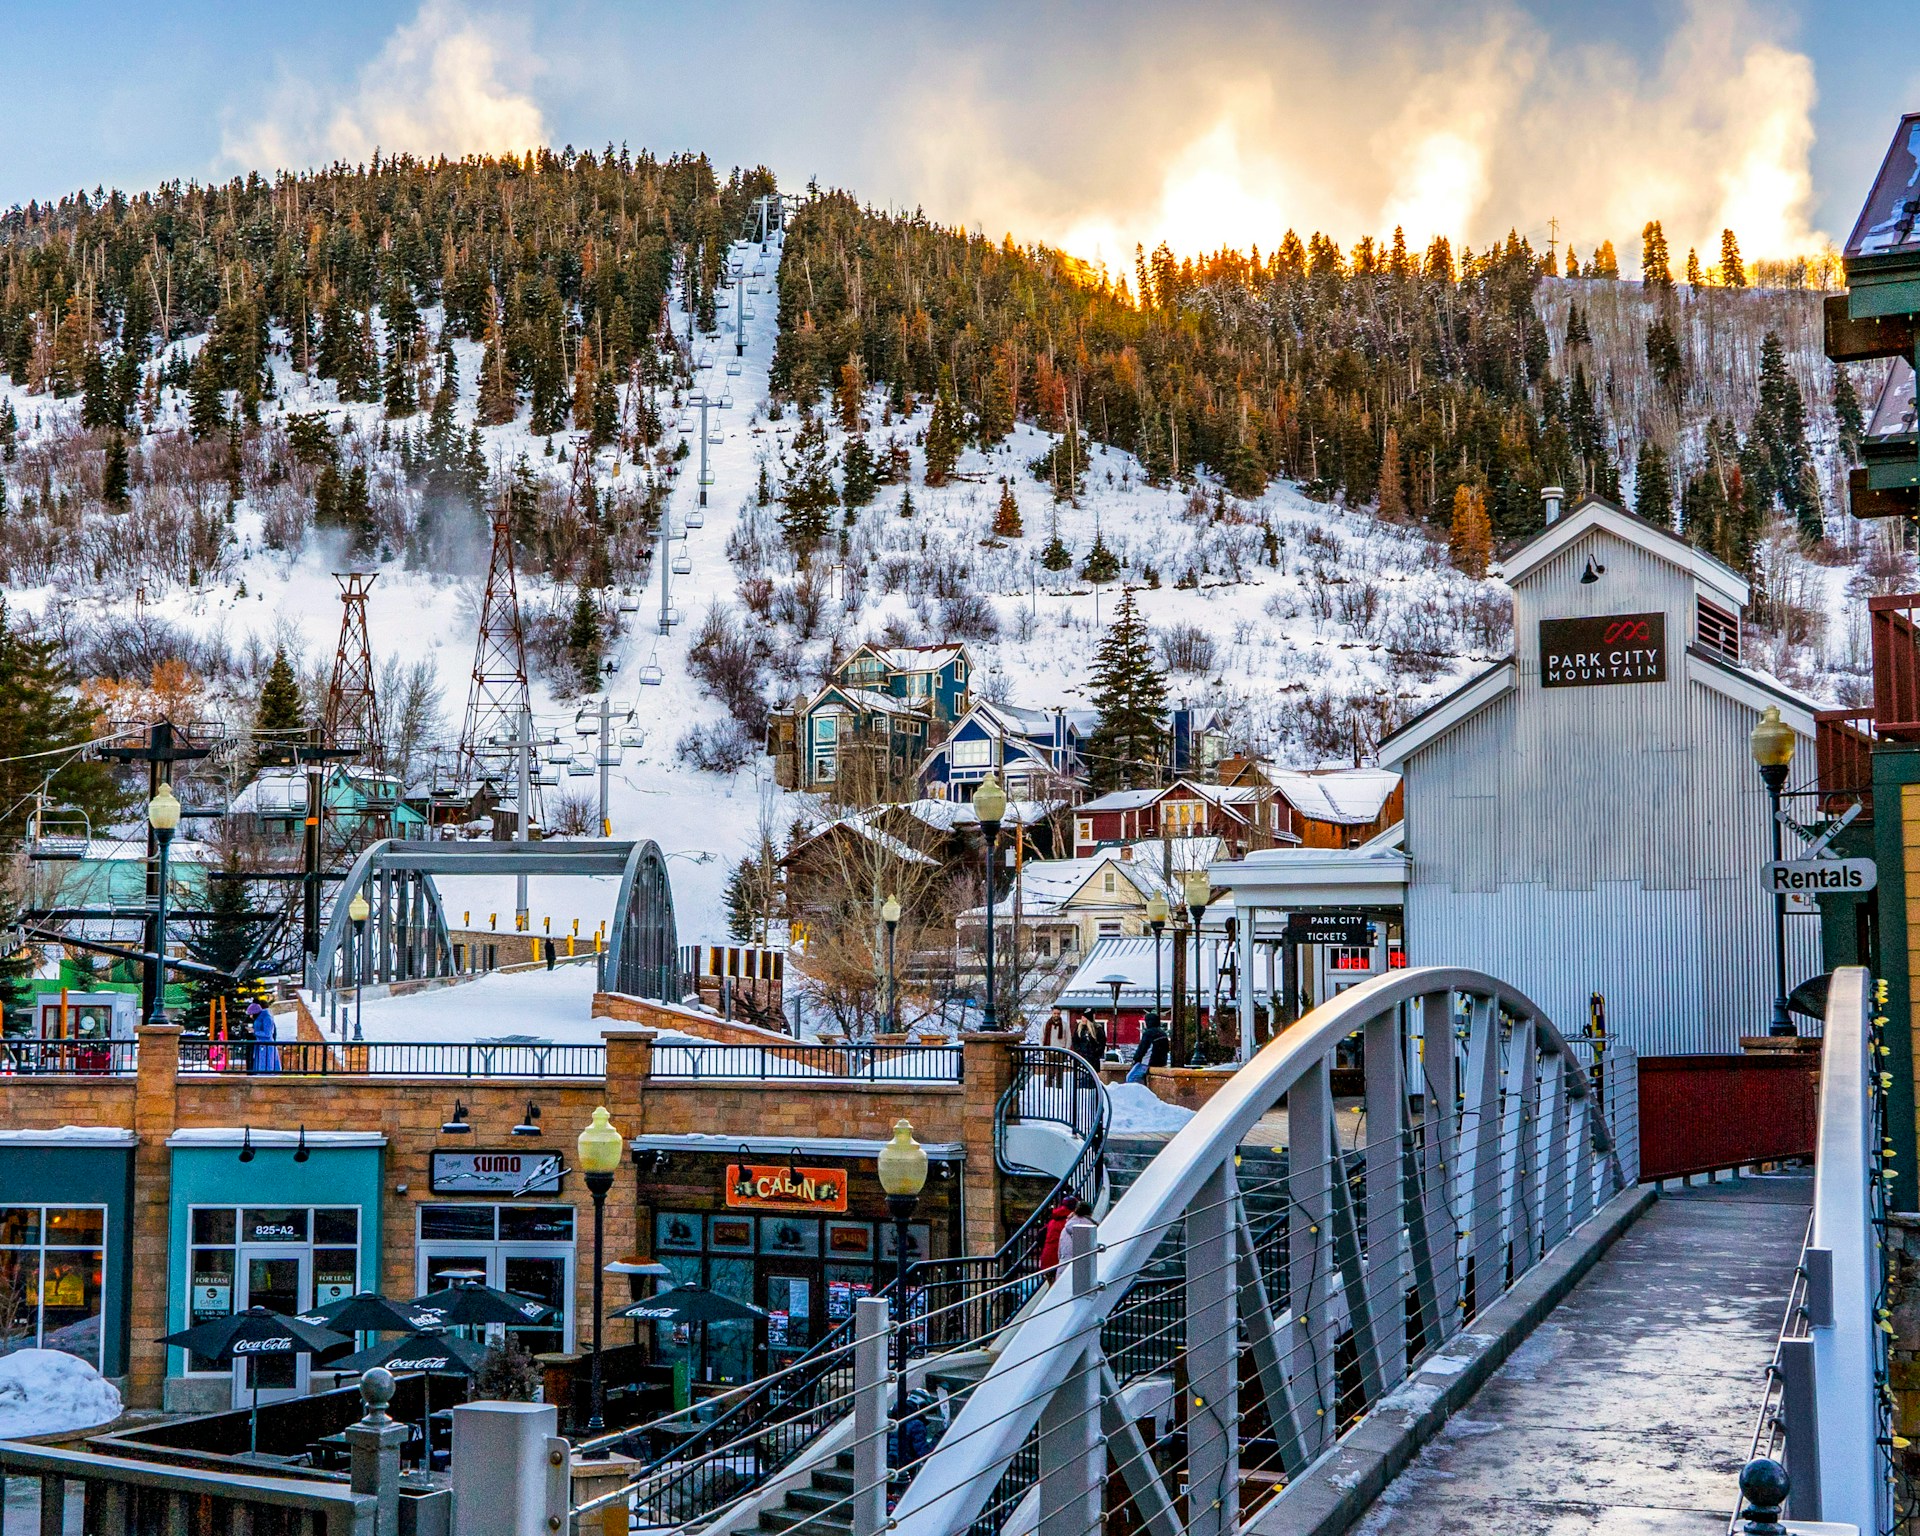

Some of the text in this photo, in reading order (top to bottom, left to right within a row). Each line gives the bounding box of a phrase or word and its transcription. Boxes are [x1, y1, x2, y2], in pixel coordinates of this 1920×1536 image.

[1549, 648, 1658, 669] PARK CITY
[1549, 664, 1657, 681] MOUNTAIN
[1784, 816, 1813, 843] TOWN
[1825, 818, 1846, 839] LIFT
[1773, 865, 1863, 890] Rentals
[1311, 916, 1363, 925] PARK CITY
[1306, 932, 1348, 941] TICKETS
[1337, 957, 1369, 970] OPEN
[473, 1156, 521, 1173] SUMO
[756, 1177, 816, 1202] CABIN
[255, 1225, 294, 1235] 825-A2
[233, 1337, 293, 1353] Coca-Cola
[384, 1357, 450, 1370] Coca-Cola
